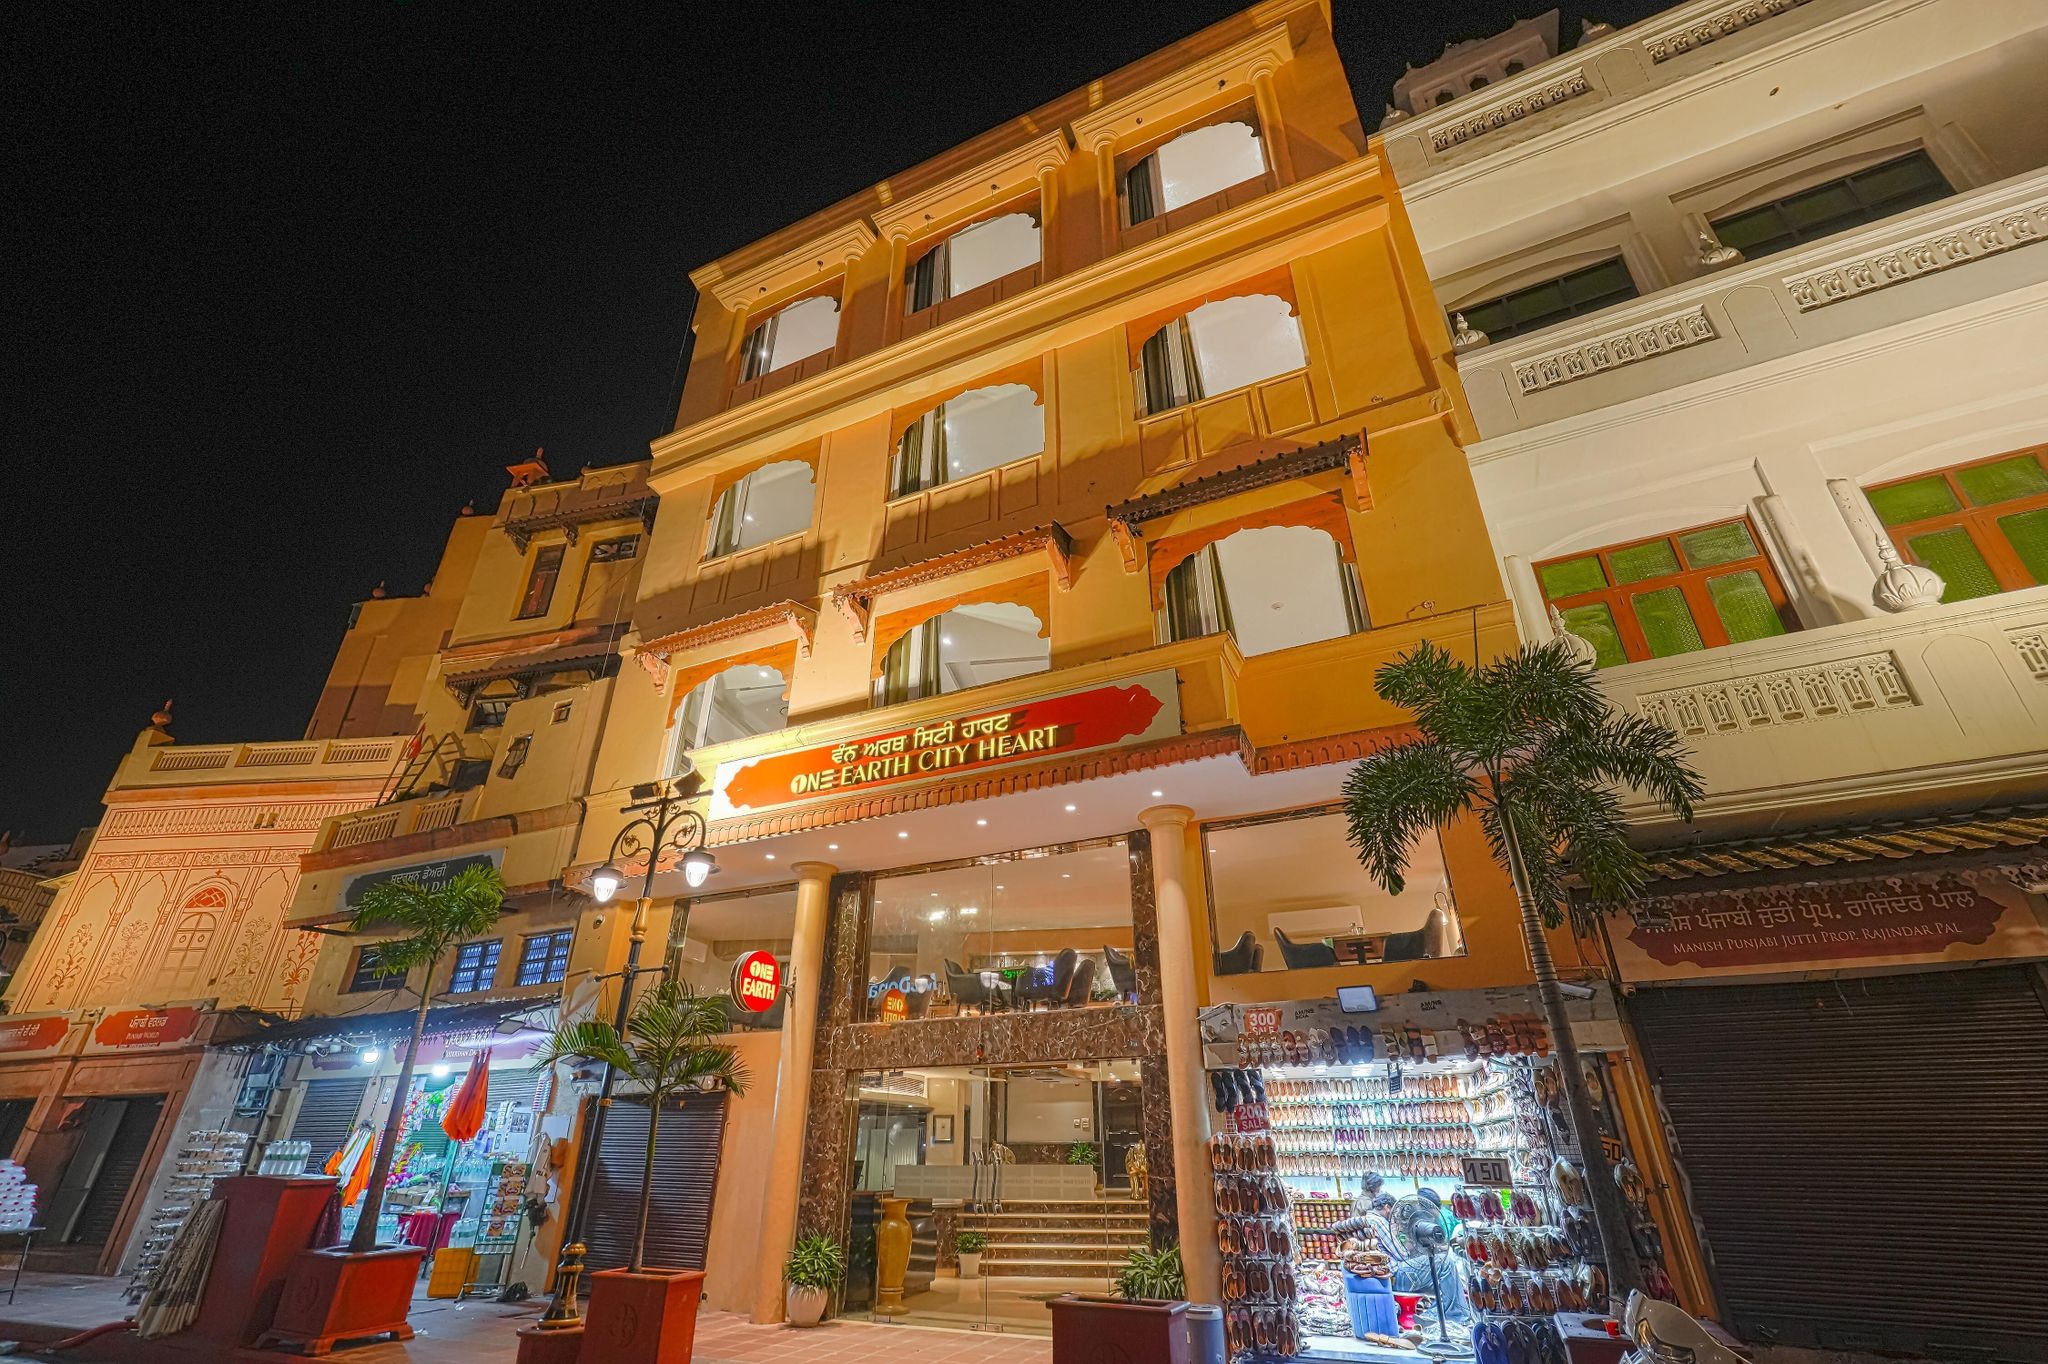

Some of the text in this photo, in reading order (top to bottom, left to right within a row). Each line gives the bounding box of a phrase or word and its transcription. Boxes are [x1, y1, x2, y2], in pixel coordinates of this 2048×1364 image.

[863, 735, 907, 757] ਅਰਥ
[913, 720, 955, 749] ਸਿਟੀ
[961, 713, 1011, 738] ਹਾਰਟ
[790, 725, 1058, 794] ONE EARTH CITY HEART
[1696, 904, 1752, 929] ਪੰਜਾਬੀ
[1756, 900, 1796, 928] ਜੁੱਤੀ
[1928, 891, 1975, 911] ਪਾਲ
[1673, 921, 1963, 954] MANISH PUNJABI JUTTI PROP. RAJINDAR PAL
[750, 960, 774, 982] ONE
[743, 977, 776, 1001] EARTH
[1249, 1012, 1276, 1026] 300
[1242, 1118, 1265, 1130] SALE
[1467, 1162, 1503, 1182] 150
